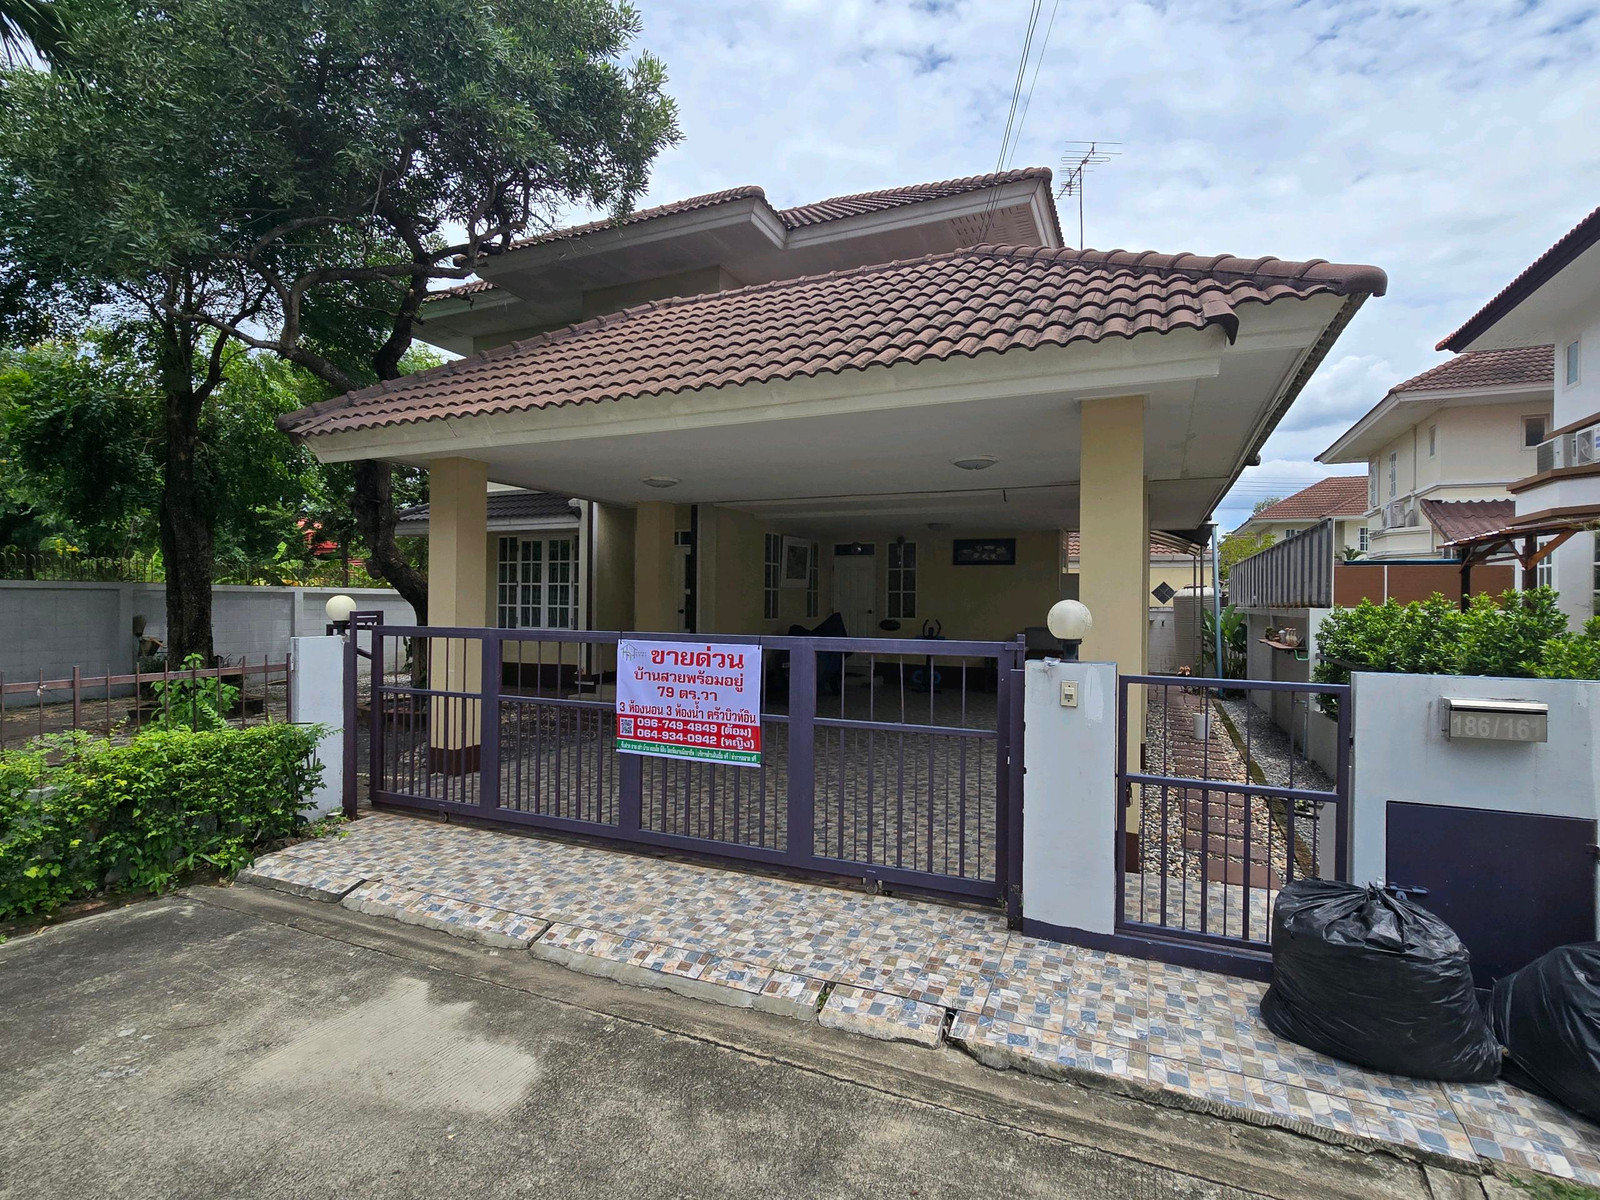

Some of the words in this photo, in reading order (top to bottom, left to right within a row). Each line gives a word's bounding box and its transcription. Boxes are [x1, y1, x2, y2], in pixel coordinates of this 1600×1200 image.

[650, 645, 744, 669] ขายด่วน
[633, 666, 744, 692] บ้านสวยพร้อมอยู่
[656, 686, 675, 698] 79
[679, 688, 718, 701] ตร.วา
[619, 701, 626, 712] 3
[628, 699, 664, 716] ห้องนอน
[666, 705, 672, 716] 3
[675, 701, 704, 720] ห้องน้ำ
[707, 706, 757, 724] ครัวบิวท์อิน
[636, 719, 718, 733] 096-749-4849
[721, 724, 752, 738] (ต้อม)
[636, 728, 718, 745] 064-934-0942
[720, 736, 755, 750] (หญิง)
